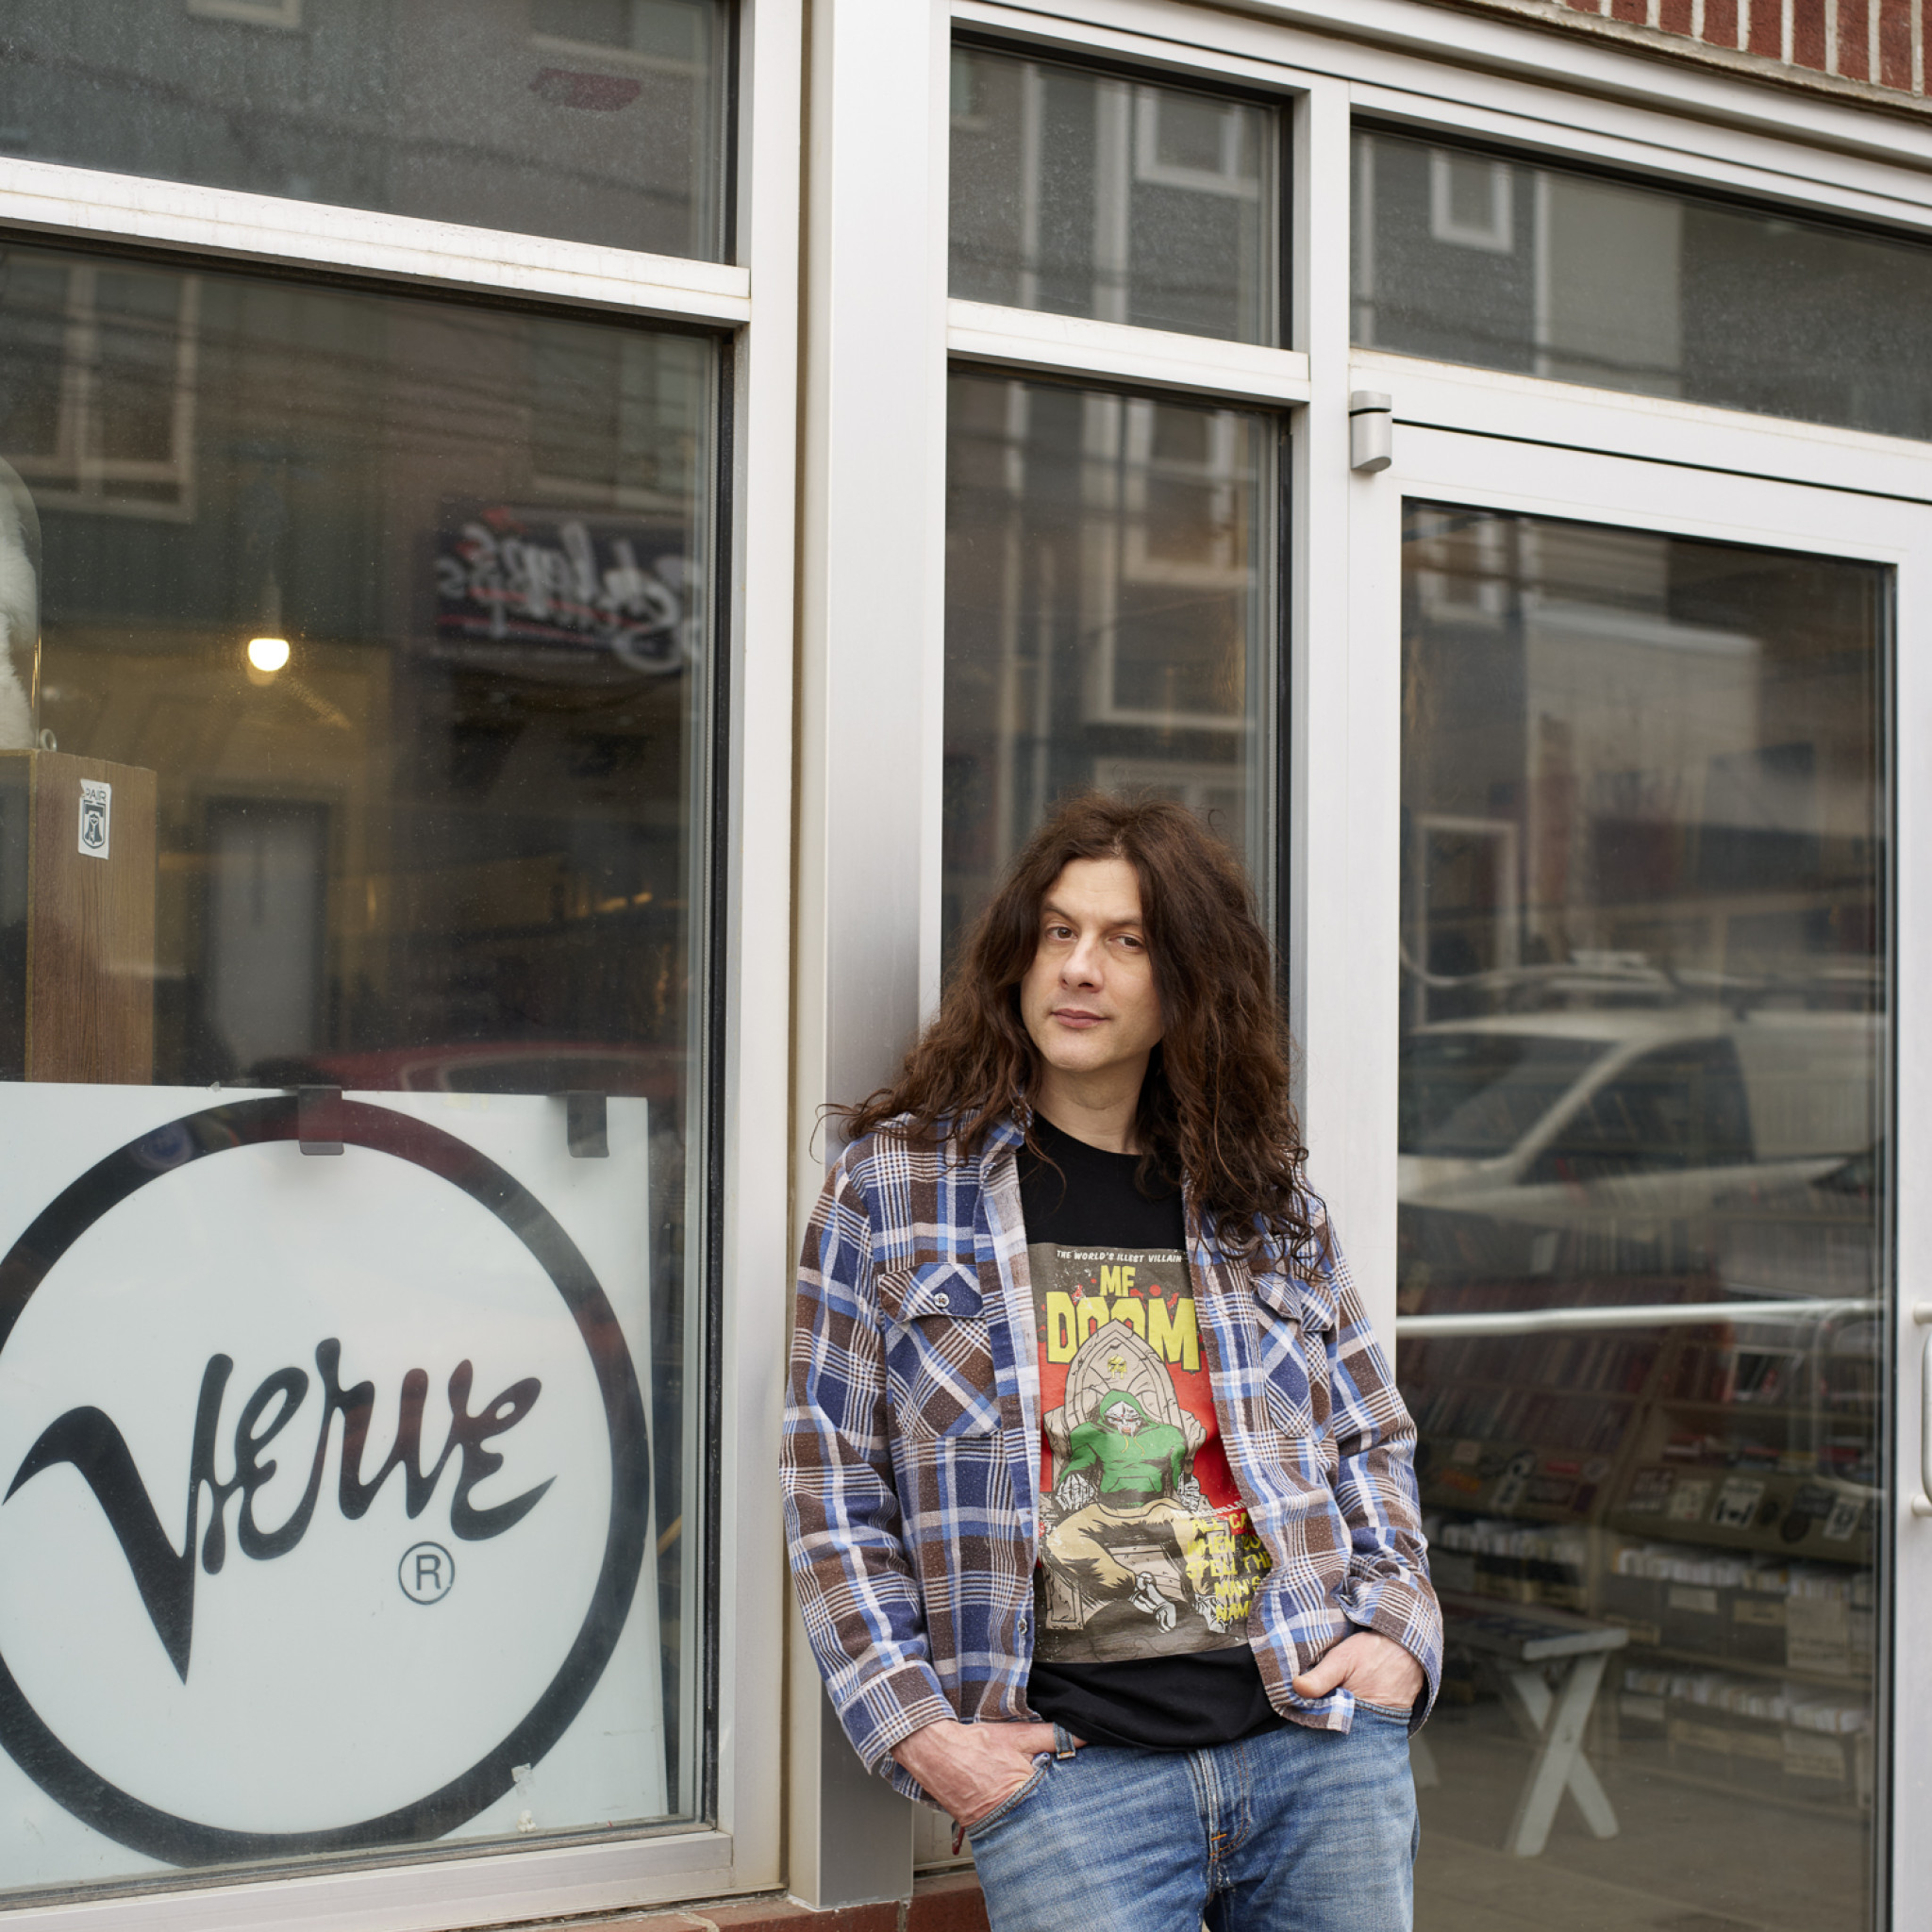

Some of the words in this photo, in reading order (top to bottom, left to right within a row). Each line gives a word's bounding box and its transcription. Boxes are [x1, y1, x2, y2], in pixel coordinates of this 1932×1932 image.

[1057, 1250, 1072, 1259] THE
[1074, 1251, 1115, 1260] WORLD'S
[1117, 1253, 1145, 1263] ILLEST
[1148, 1254, 1182, 1263] VILLAIN
[1099, 1264, 1136, 1298] MF
[1045, 1291, 1201, 1372] DOOM
[1191, 1517, 1224, 1534] ALL
[1187, 1534, 1237, 1557] WHEN
[1186, 1556, 1238, 1580] SPELL
[1215, 1600, 1252, 1624] NAM
